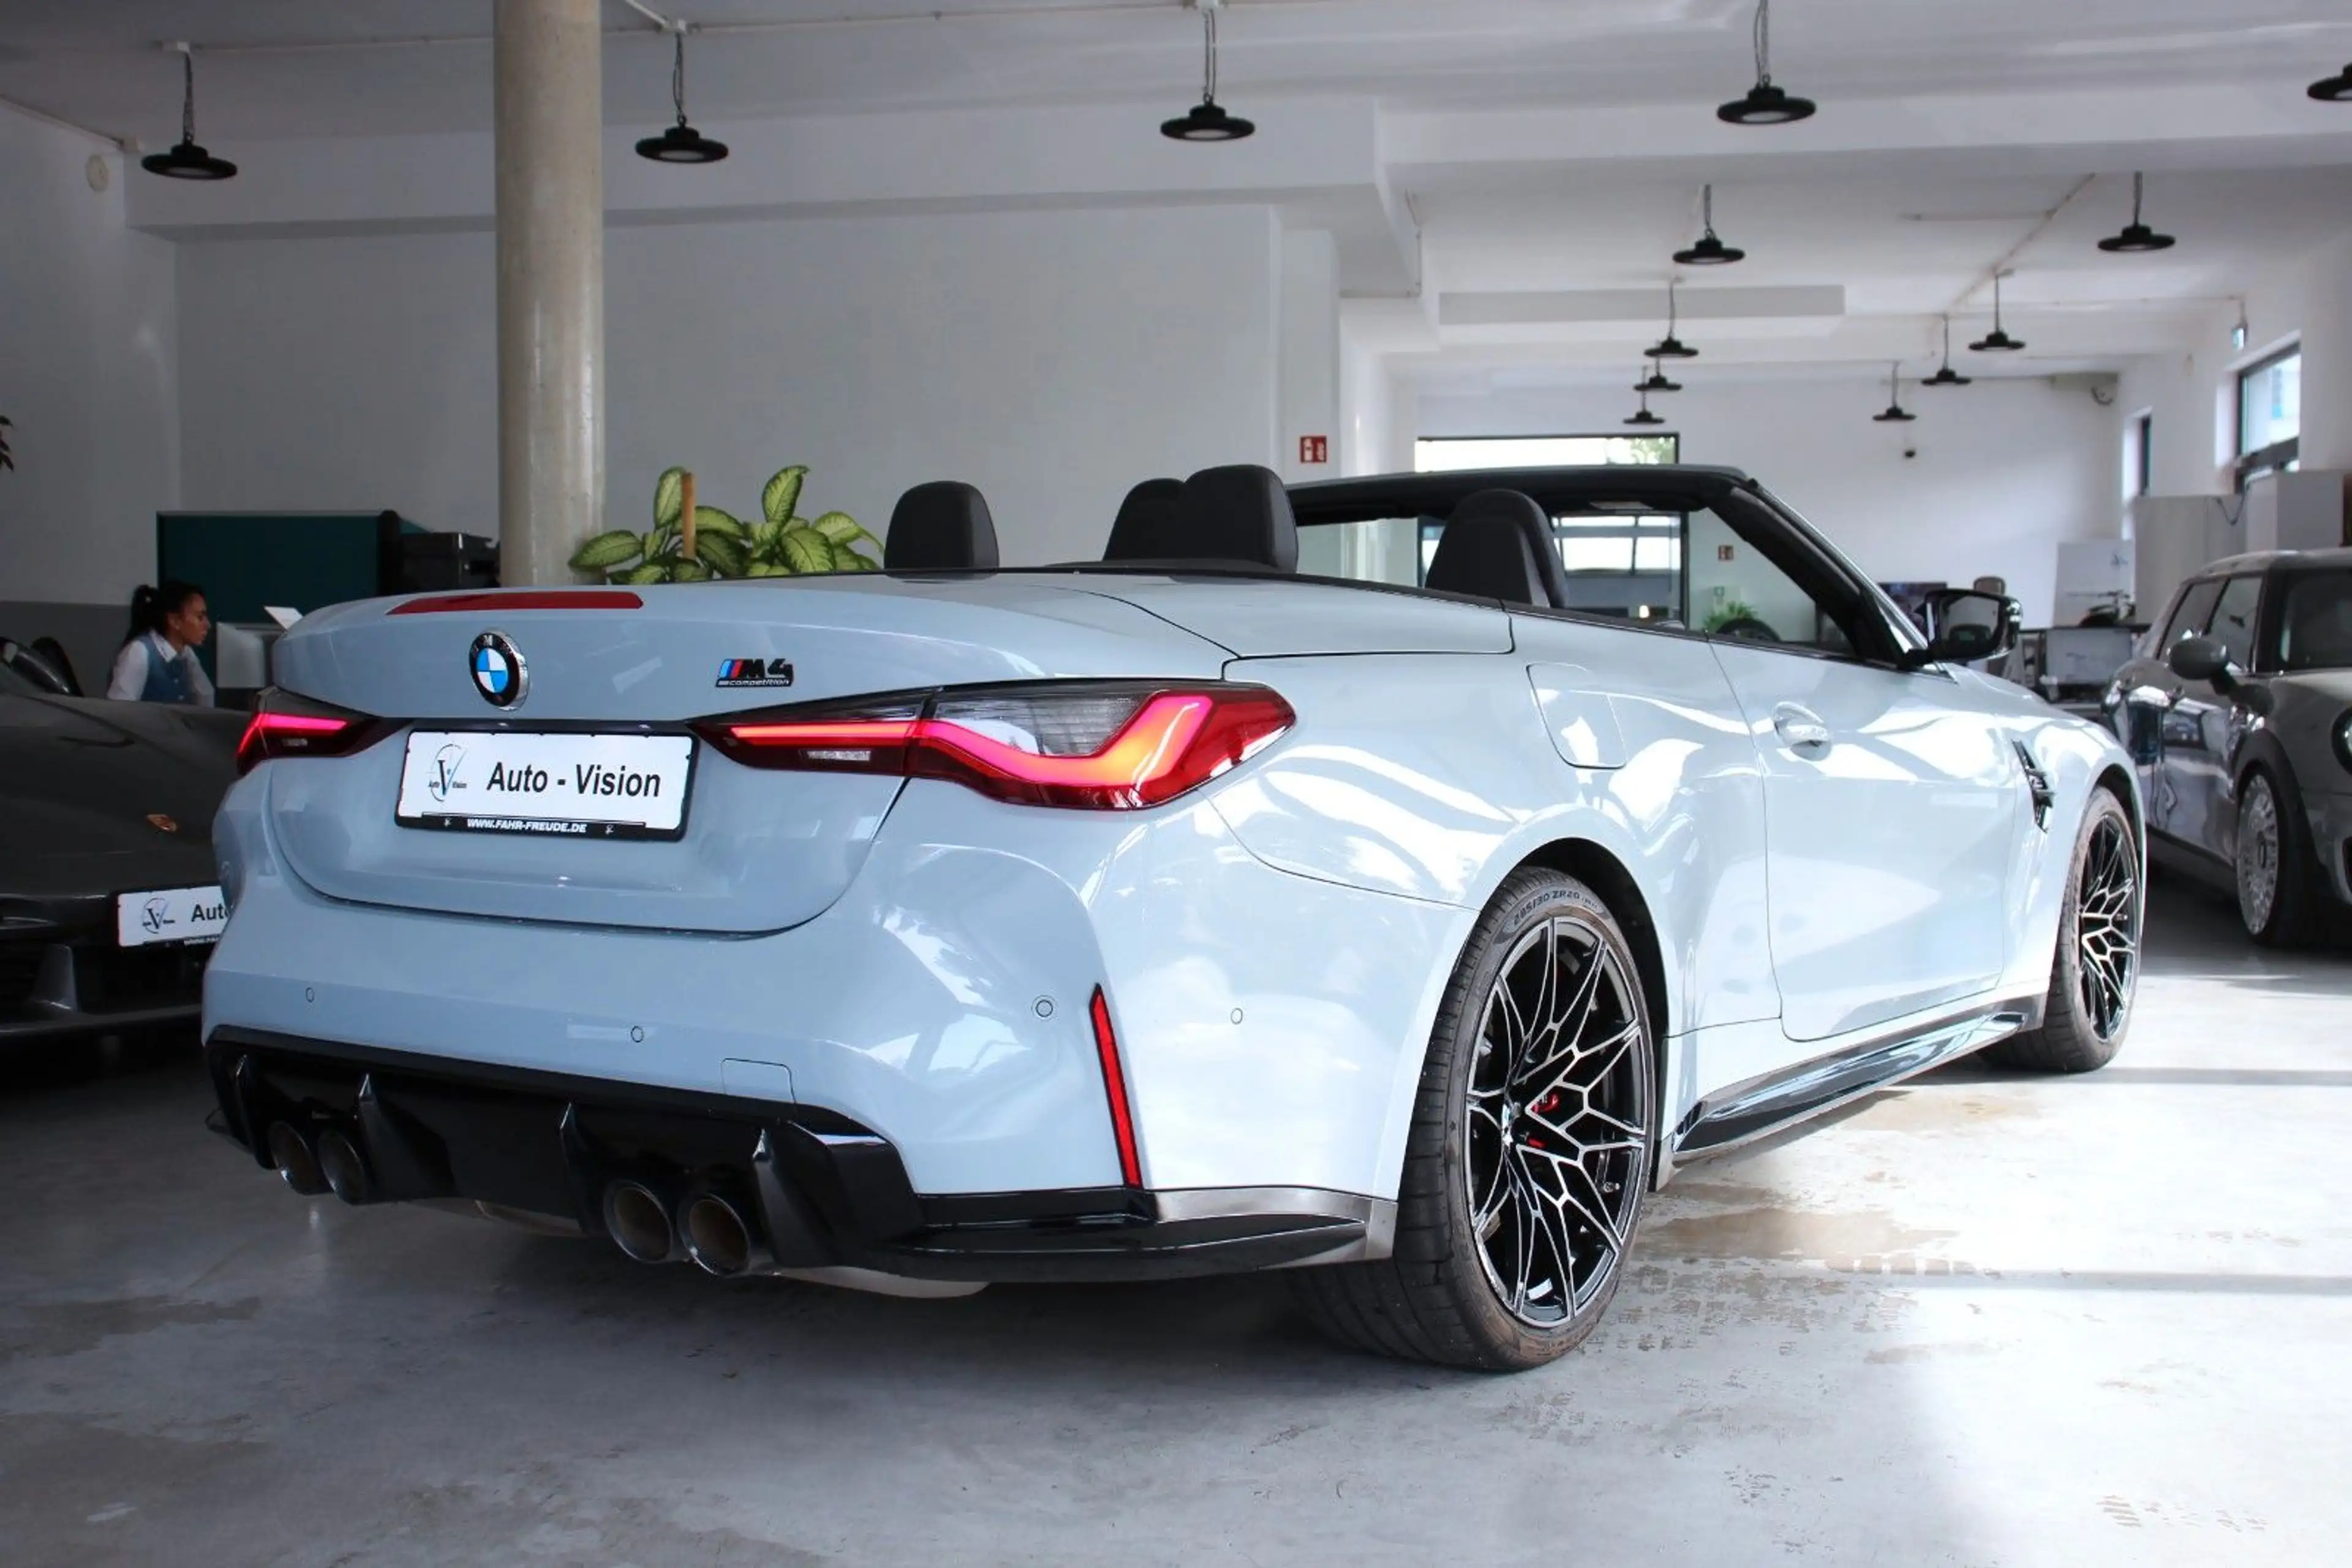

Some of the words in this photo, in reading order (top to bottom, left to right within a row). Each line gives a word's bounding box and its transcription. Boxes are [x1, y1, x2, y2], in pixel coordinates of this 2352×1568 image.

[733, 658, 794, 680] M4
[487, 762, 549, 793] Auto
[576, 764, 660, 797] Vision
[467, 818, 587, 834] WWW.FAHR-FREUDE.DE
